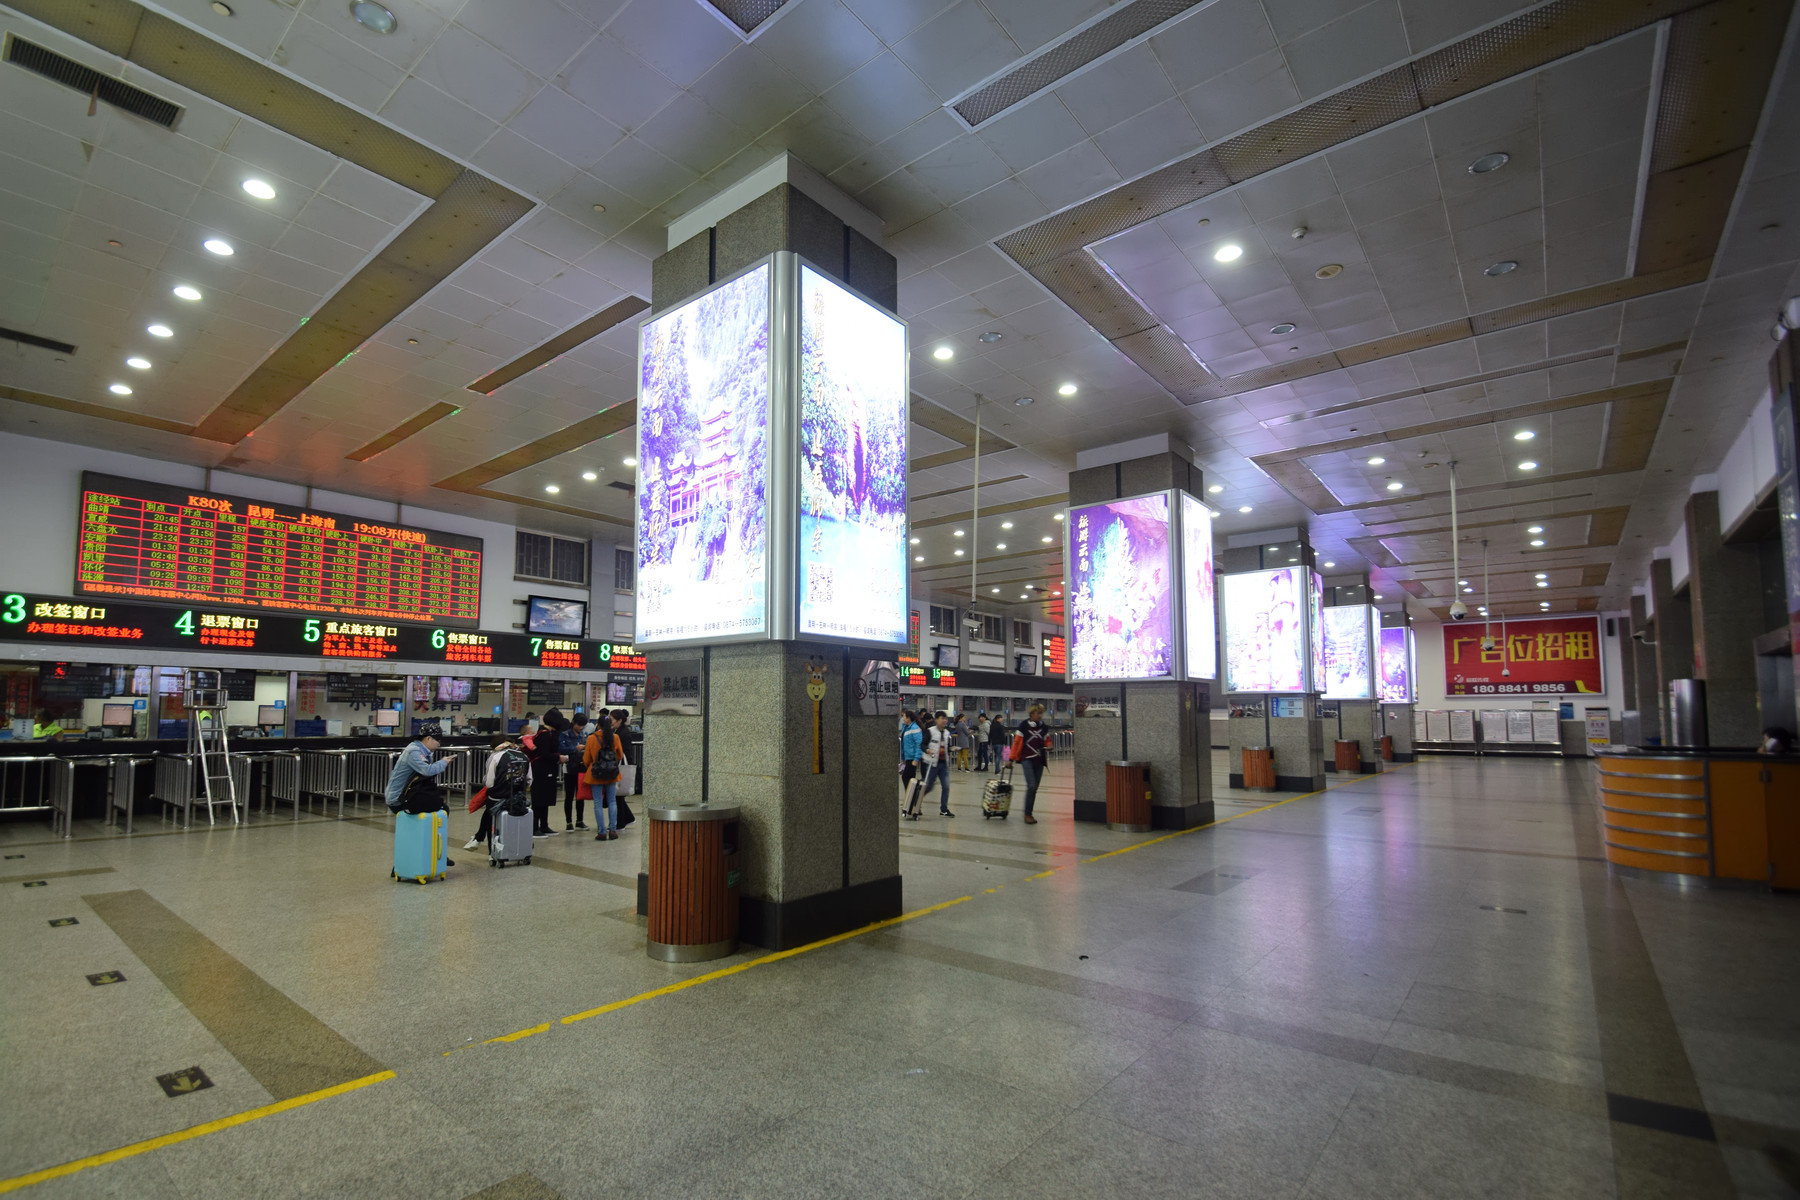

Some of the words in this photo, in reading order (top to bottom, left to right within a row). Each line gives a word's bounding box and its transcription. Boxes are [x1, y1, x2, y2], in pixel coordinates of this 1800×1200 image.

[189, 496, 232, 512] K80次
[88, 504, 109, 513] 曲靖
[154, 514, 179, 523] 20:45
[191, 519, 214, 528] 20:51
[86, 524, 117, 534] 六盘水
[153, 533, 178, 541] 23:24
[190, 538, 213, 546] 23:37
[154, 523, 178, 532] 21:49
[190, 528, 214, 537] 21:56
[85, 533, 106, 542] 安顺
[152, 542, 177, 551] 01:30
[189, 547, 213, 555] 01:34
[85, 543, 106, 552] 贵阳
[151, 552, 176, 560] 02:48
[188, 556, 212, 564] 03:04
[83, 553, 104, 562] 凯里
[150, 561, 176, 569] 05:26
[187, 565, 212, 573] 05:32
[83, 563, 104, 572] 怀化
[150, 570, 175, 579] 09:25
[187, 574, 211, 582] 09:33
[3, 594, 26, 623] 3
[34, 603, 106, 620] 改签窗口
[27, 622, 144, 639] 办理签证和改签业务
[174, 610, 195, 636] 4
[201, 614, 259, 629] 退票窗口
[304, 619, 320, 642] 5
[326, 622, 397, 636] 重点旅客窗口
[432, 630, 445, 649] 6
[448, 633, 487, 644] 售票窗口
[531, 638, 542, 656] 7
[1453, 631, 1595, 664] 广告位招租
[601, 644, 610, 661] 8
[901, 666, 909, 676] 14
[933, 668, 940, 678] 15
[664, 676, 698, 691] 禁止吸烟
[1498, 684, 1528, 692] 8841
[1532, 684, 1565, 692] 9856
